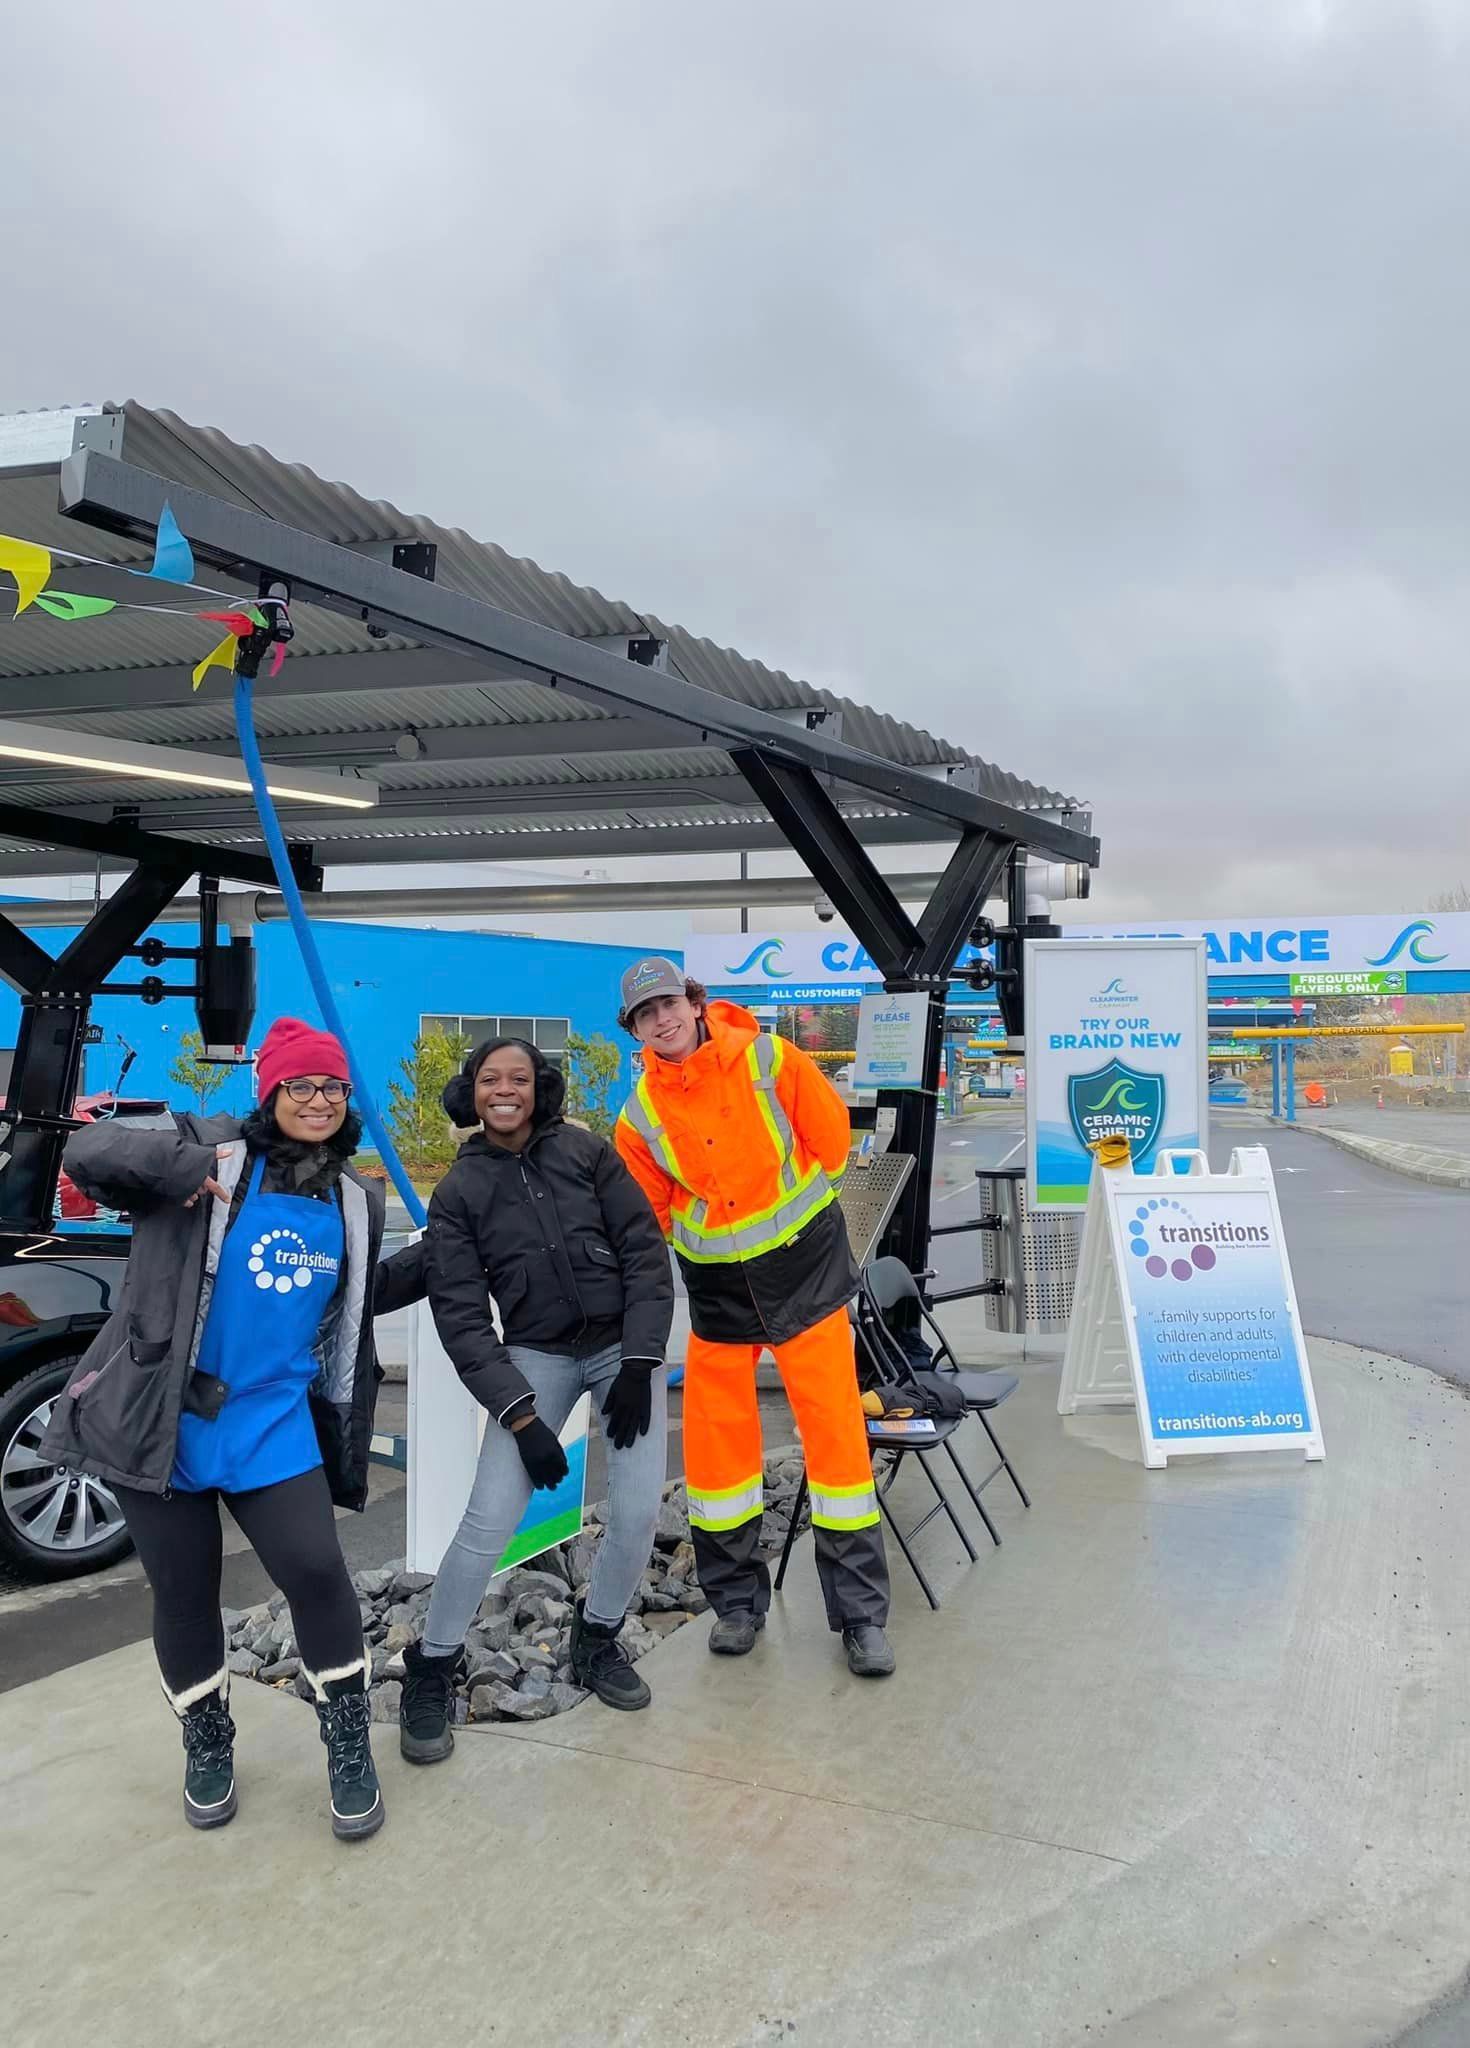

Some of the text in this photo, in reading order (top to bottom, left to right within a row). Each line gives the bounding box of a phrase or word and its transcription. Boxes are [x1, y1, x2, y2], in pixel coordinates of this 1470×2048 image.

[821, 942, 877, 972] CA
[1300, 973, 1371, 984] FREQUENT
[771, 988, 862, 998] ALL CUSTOMERS
[1294, 983, 1380, 994] FLYERS ONLY
[873, 1012, 910, 1022] PLEASE
[1080, 1018, 1149, 1031] TRY OUR
[1330, 1026, 1388, 1035] CLEARANCE
[1050, 1033, 1182, 1049] BRAND NEW
[1083, 1114, 1152, 1127] CERAMIC
[1089, 1127, 1146, 1140] SHIELD
[1159, 1221, 1269, 1243] transitions
[275, 1249, 338, 1270] transitions
[1202, 1309, 1257, 1324] supports
[1259, 1307, 1277, 1320] for
[1156, 1326, 1277, 1344] children and adults,
[1157, 1346, 1281, 1364] with developmental
[1158, 1410, 1303, 1431] transitions-ab.org
